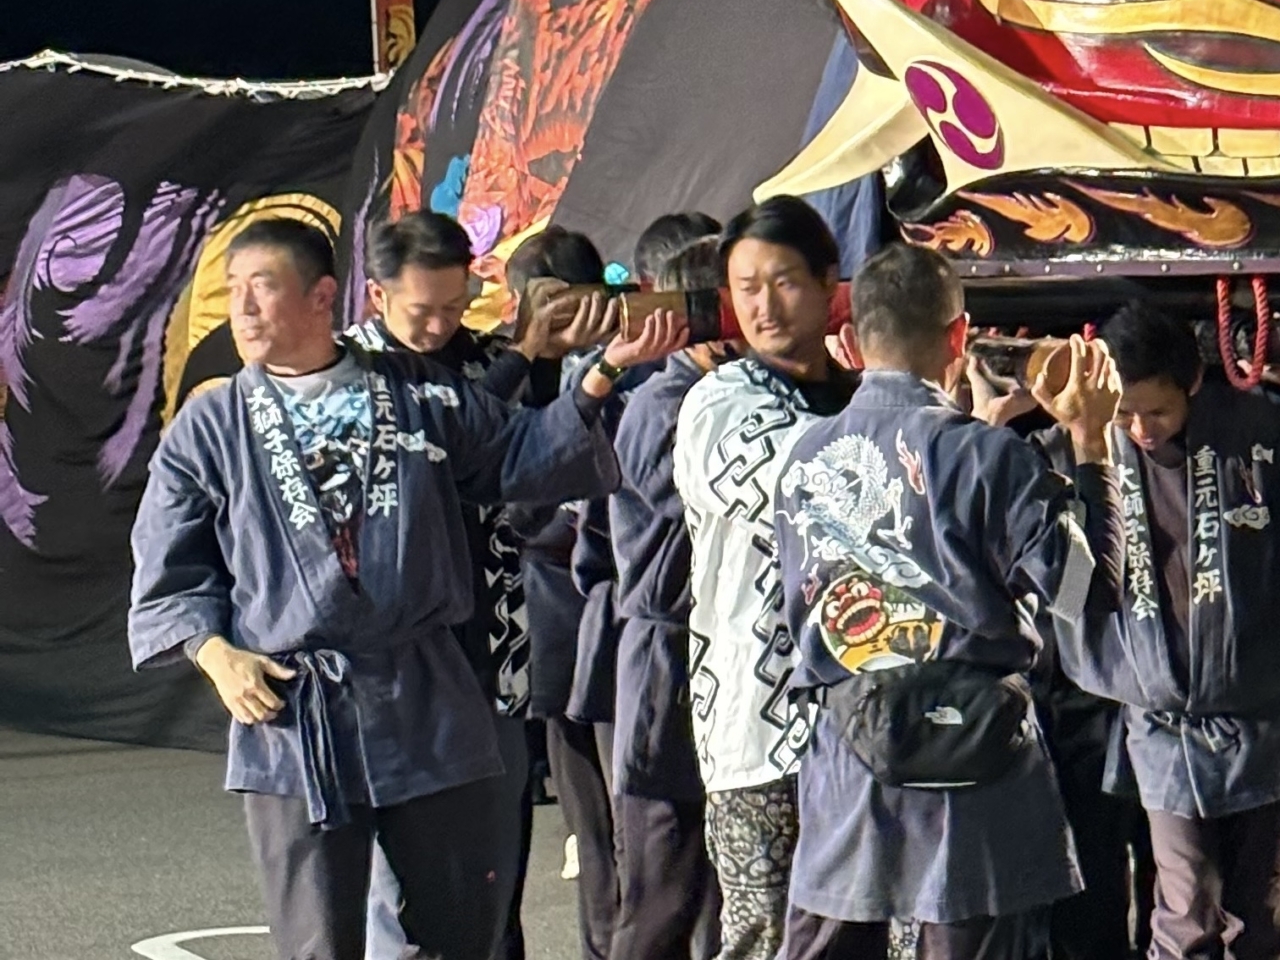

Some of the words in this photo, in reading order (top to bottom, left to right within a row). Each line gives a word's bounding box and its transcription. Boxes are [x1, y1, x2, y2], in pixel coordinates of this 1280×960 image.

[245, 385, 318, 531] 大獅子保存会
